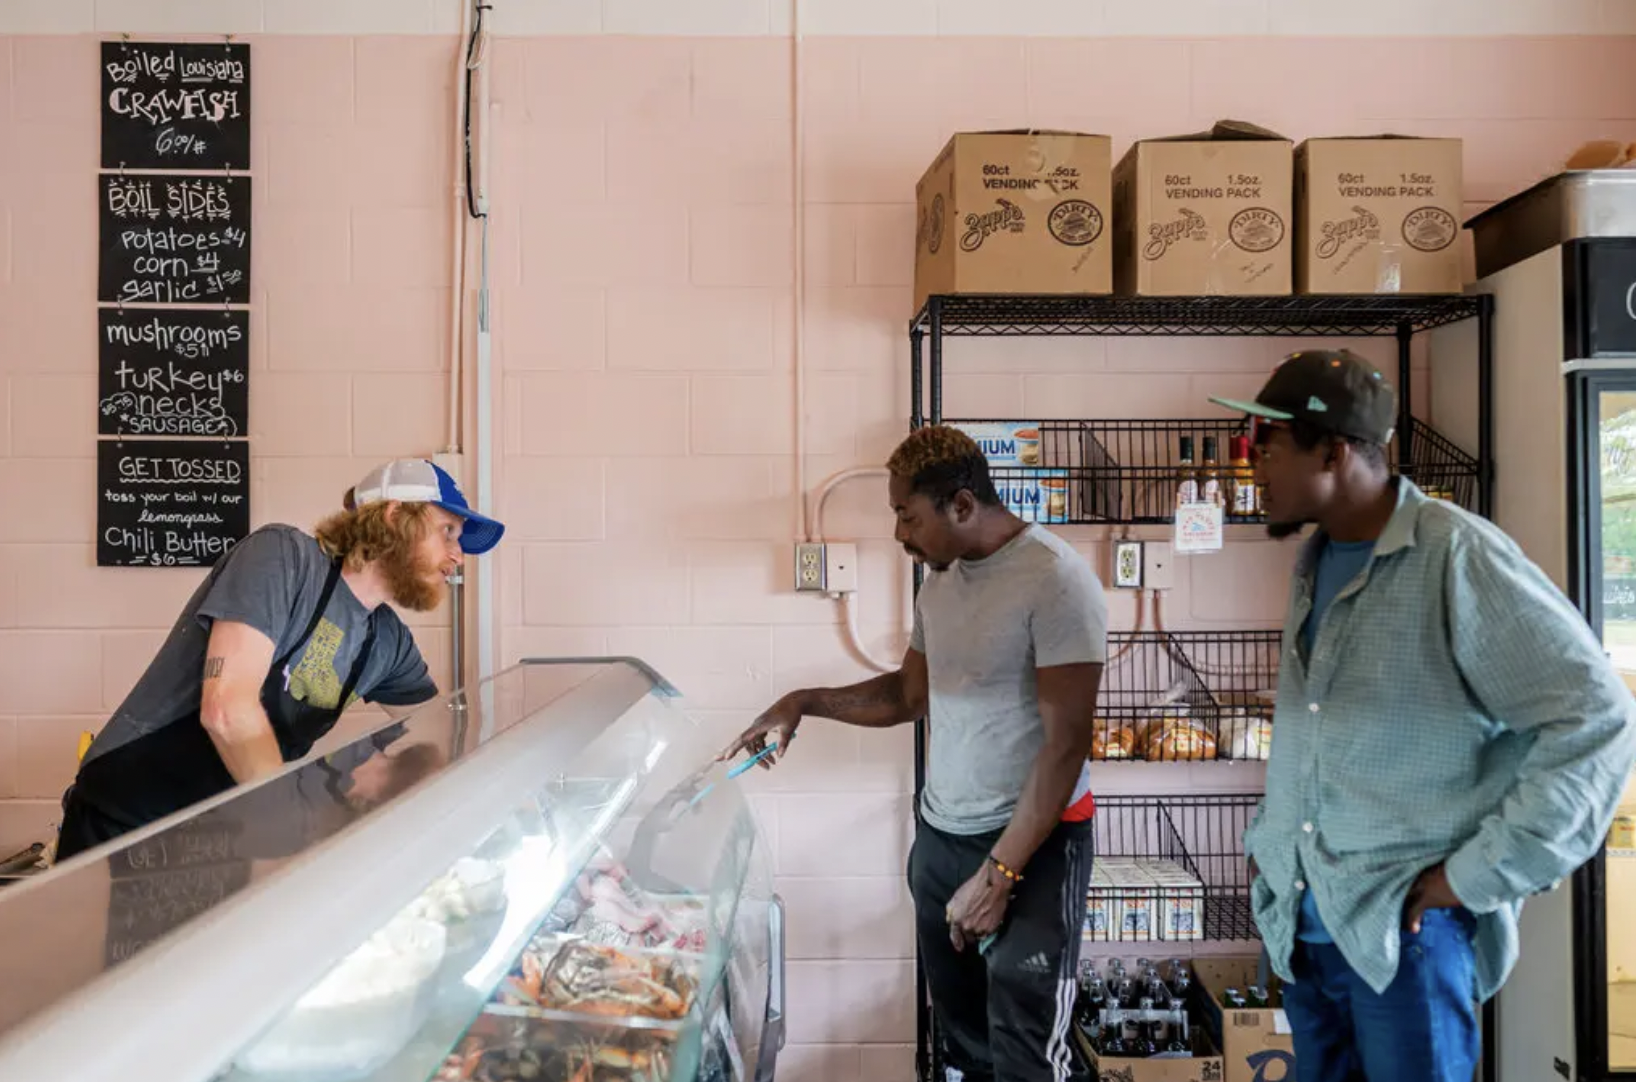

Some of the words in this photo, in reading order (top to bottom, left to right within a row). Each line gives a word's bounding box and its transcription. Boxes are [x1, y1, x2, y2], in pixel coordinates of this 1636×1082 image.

[106, 50, 175, 82] Boiled
[180, 57, 245, 80] Louisiana
[109, 87, 241, 125] CRAWFISH
[983, 165, 1011, 176] 60ct
[1337, 173, 1365, 183] 60ct
[1165, 174, 1192, 185] 60ct
[1227, 174, 1262, 185] 1.5oz.
[1165, 187, 1223, 199] VENDING
[1226, 187, 1262, 198] PACK
[1339, 186, 1397, 197] VENDING
[1400, 186, 1435, 197] PACK
[109, 186, 160, 213] BOIL
[167, 186, 230, 215] SIDES
[1054, 203, 1098, 220] DIRTY
[1408, 211, 1452, 228] DIRTY
[1234, 212, 1279, 229] DIRTY
[133, 256, 189, 277] corn
[121, 279, 201, 302] garlic
[106, 317, 242, 350] mushrooms
[223, 369, 244, 383] $6
[129, 417, 219, 434] SAUSAGE
[977, 439, 1015, 454] IUM
[118, 456, 163, 478] GET
[165, 458, 241, 480] TOSSED
[105, 489, 136, 502] toss
[140, 493, 170, 507] your
[174, 491, 197, 503] boil
[202, 492, 218, 505] w/
[220, 494, 243, 504] our
[138, 508, 224, 529] lemongrass
[105, 527, 155, 554] Chili
[165, 531, 236, 557] Butter
[150, 551, 176, 566] $6
[1202, 1060, 1221, 1071] 24
